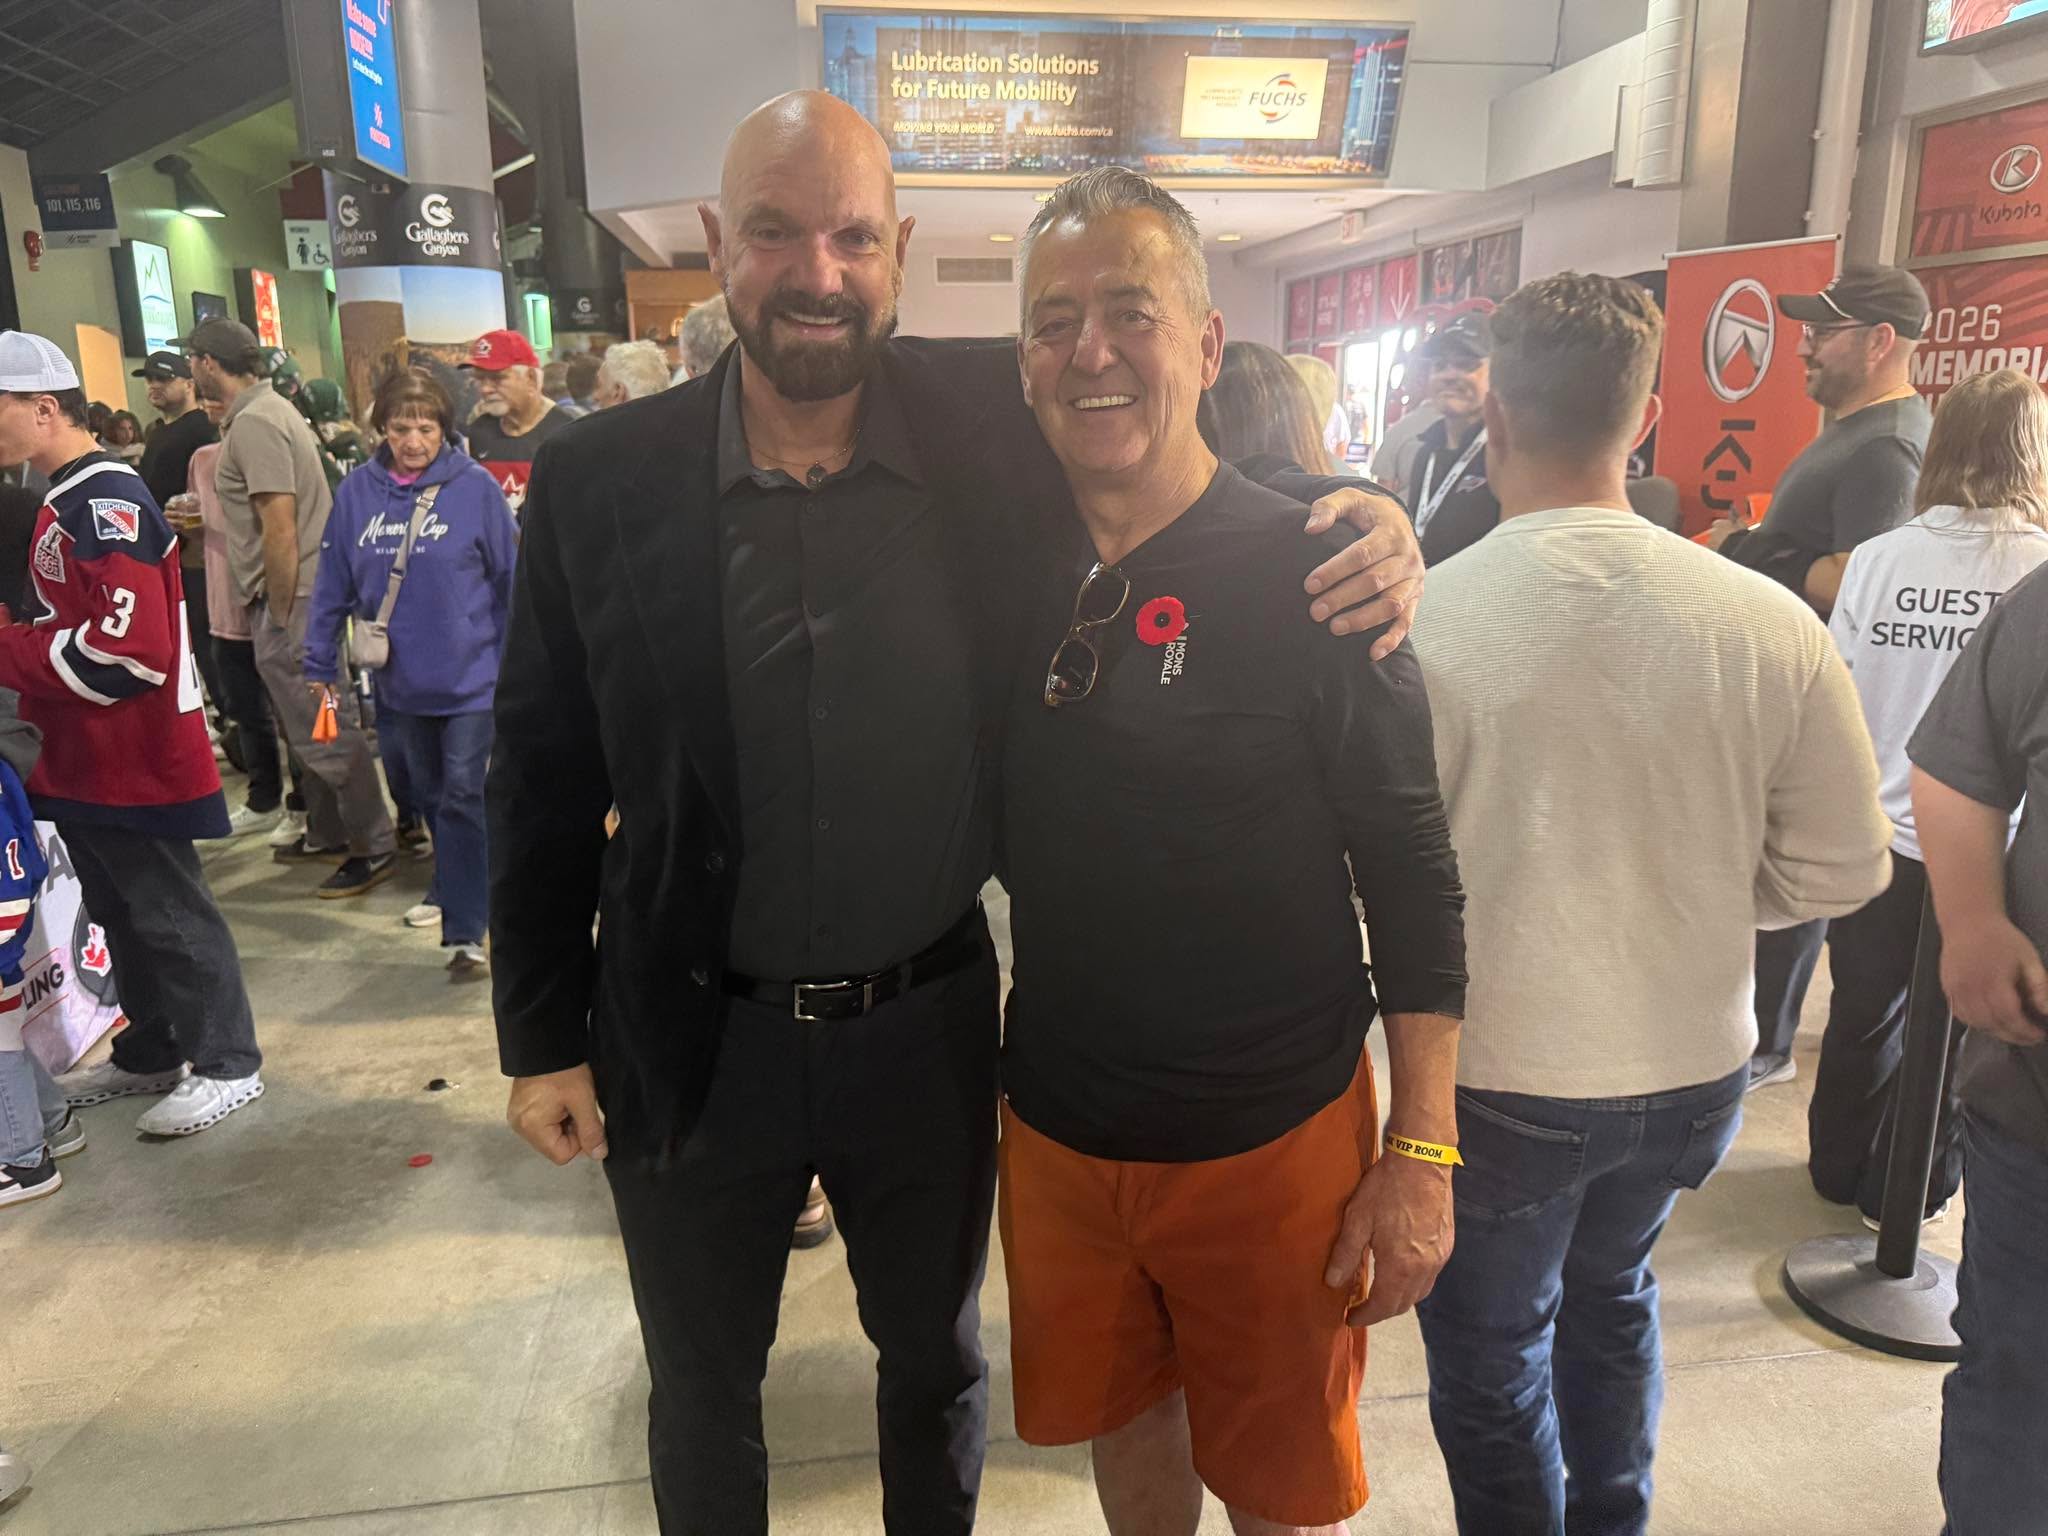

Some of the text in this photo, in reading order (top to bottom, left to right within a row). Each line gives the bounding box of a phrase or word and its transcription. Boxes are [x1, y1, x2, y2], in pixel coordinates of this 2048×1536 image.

[891, 49, 1100, 76] Lubrication Solutions
[891, 77, 1078, 106] for Future Mobility
[1249, 92, 1308, 107] FUCHS
[1979, 200, 2042, 225] Kubota
[421, 241, 461, 258] Canyon
[104, 510, 131, 535] RANGERS
[358, 511, 449, 547] Memori Cup
[101, 585, 136, 639] 3
[1896, 587, 2003, 616] GUEST
[1870, 622, 1977, 652] SERVIC
[1160, 641, 1177, 685] ROYALE
[1172, 642, 1187, 676] MONS
[3, 838, 25, 881] 1
[21, 962, 65, 1011] LING
[1396, 1139, 1413, 1153] VIP
[1414, 1145, 1443, 1159] ROOM
